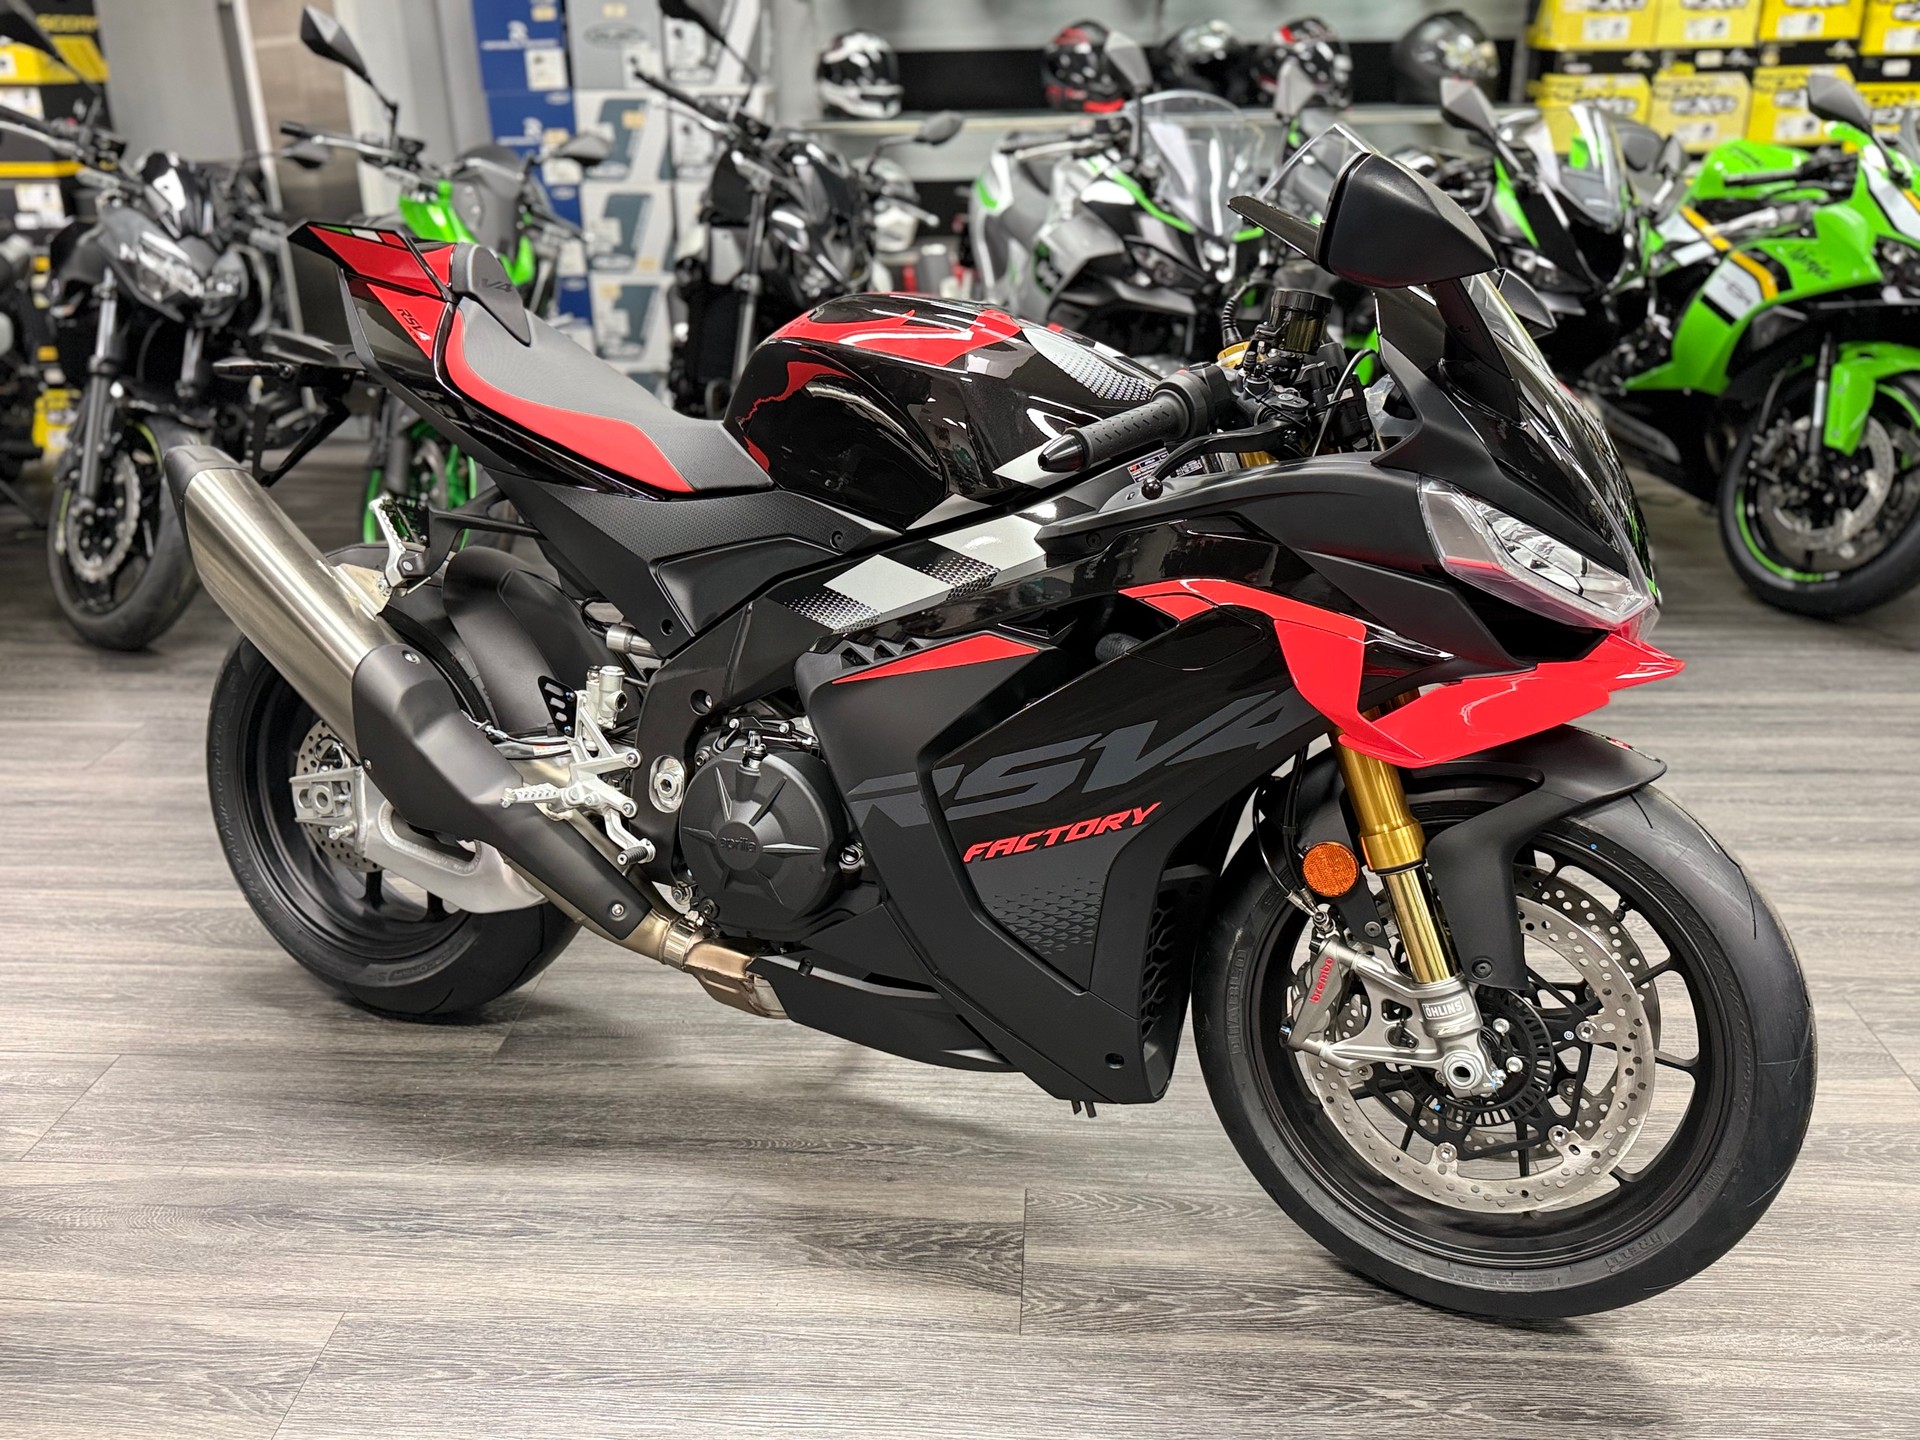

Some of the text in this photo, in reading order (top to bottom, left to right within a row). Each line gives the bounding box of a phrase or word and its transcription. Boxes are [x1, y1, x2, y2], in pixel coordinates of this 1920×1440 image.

[481, 278, 511, 293] V4
[396, 308, 432, 341] RSV4
[847, 686, 1320, 828] RSV4
[963, 801, 1163, 864] FACTORY
[1309, 956, 1335, 1005] brembo
[1425, 1001, 1463, 1018] ÖHLINS
